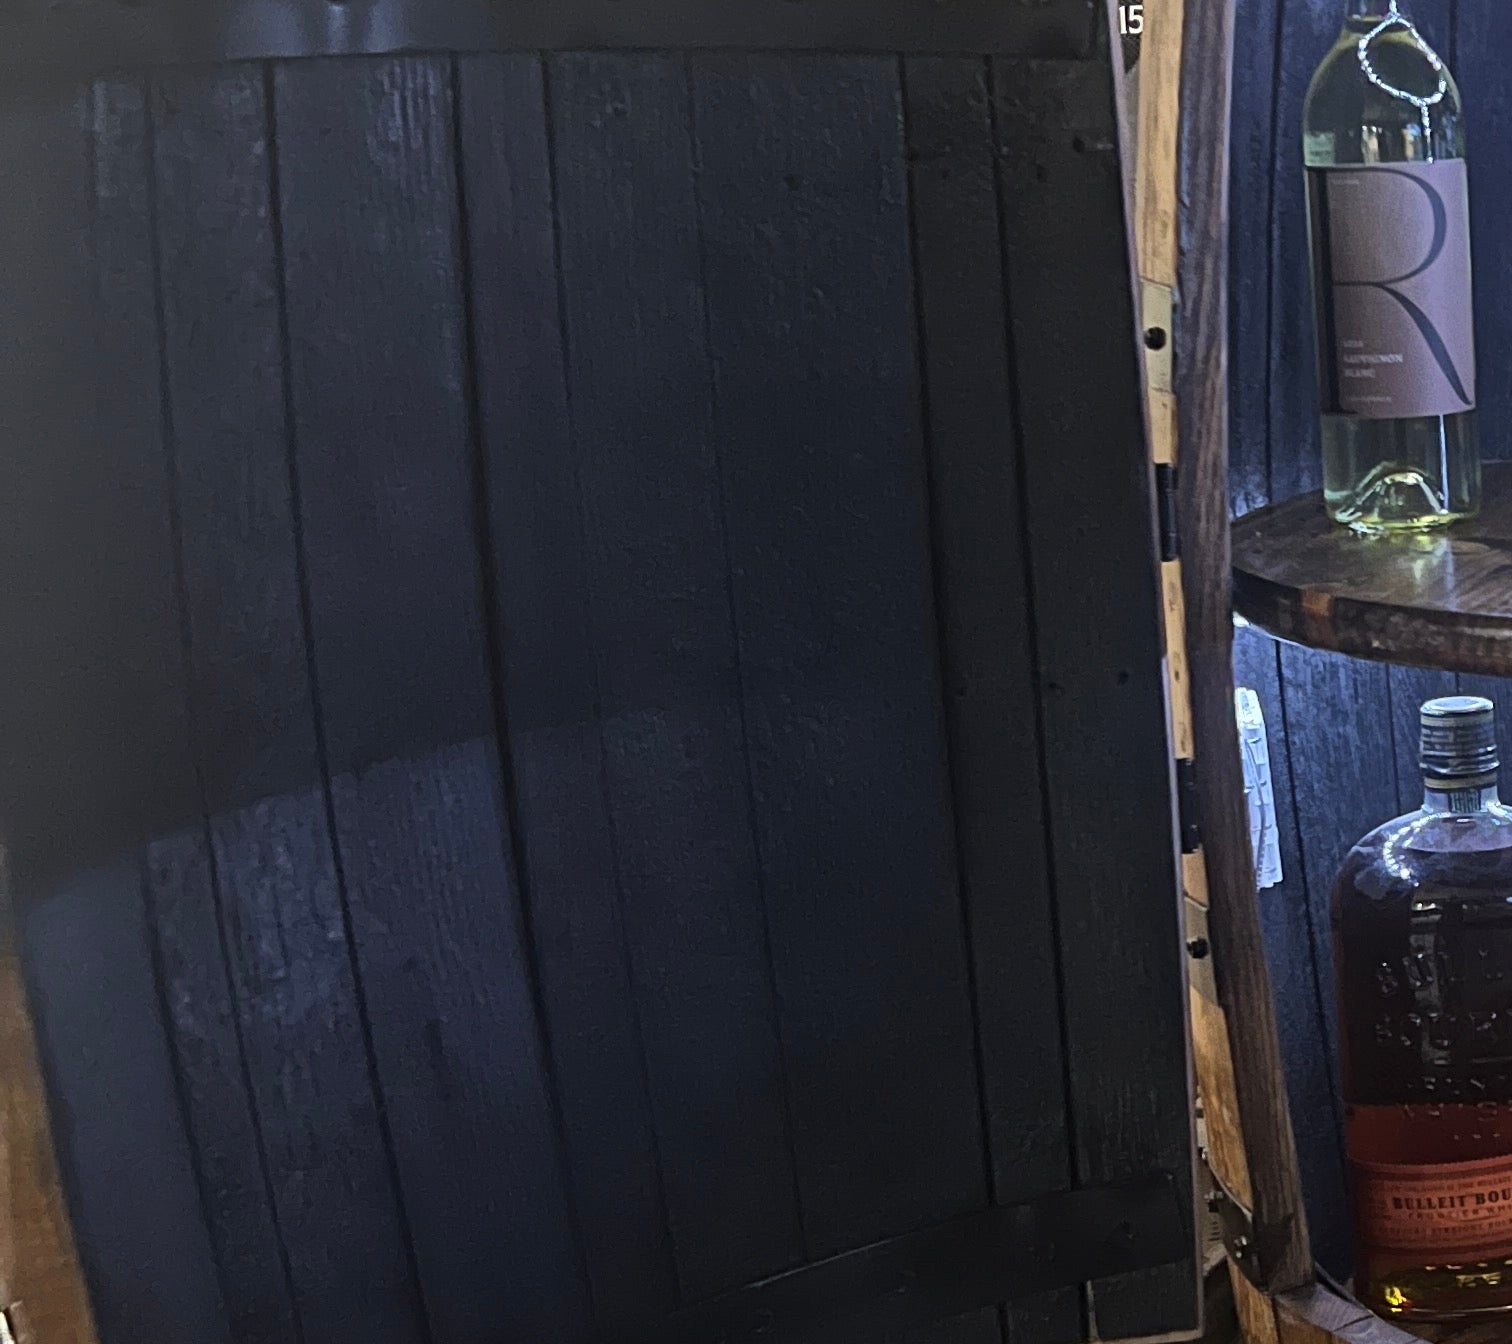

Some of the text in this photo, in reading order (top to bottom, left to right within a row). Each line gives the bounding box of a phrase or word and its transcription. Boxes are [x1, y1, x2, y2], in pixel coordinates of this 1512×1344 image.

[1118, 4, 1145, 35] 15
[1306, 166, 1474, 416] R
[1392, 1195, 1468, 1211] BULLEIT
